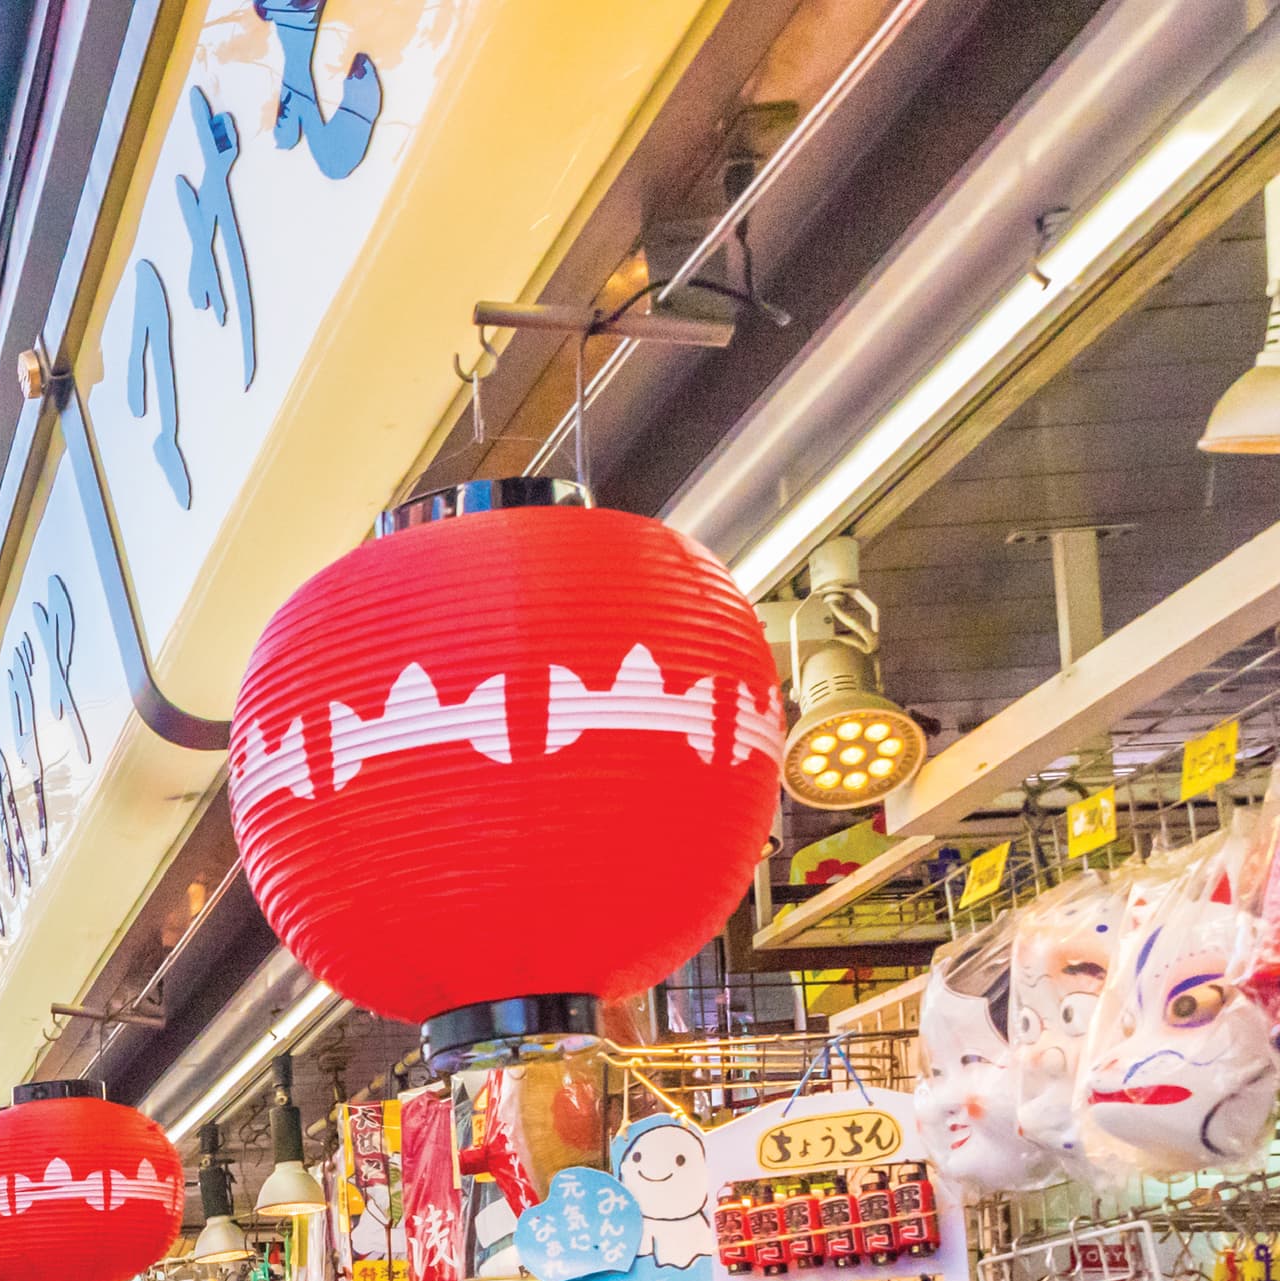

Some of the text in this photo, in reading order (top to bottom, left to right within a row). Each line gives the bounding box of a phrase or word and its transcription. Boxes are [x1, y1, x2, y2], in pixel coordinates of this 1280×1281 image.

[766, 1117, 896, 1164] ちょうちん
[557, 1172, 591, 1252] 元気に
[597, 1186, 630, 1264] みんな
